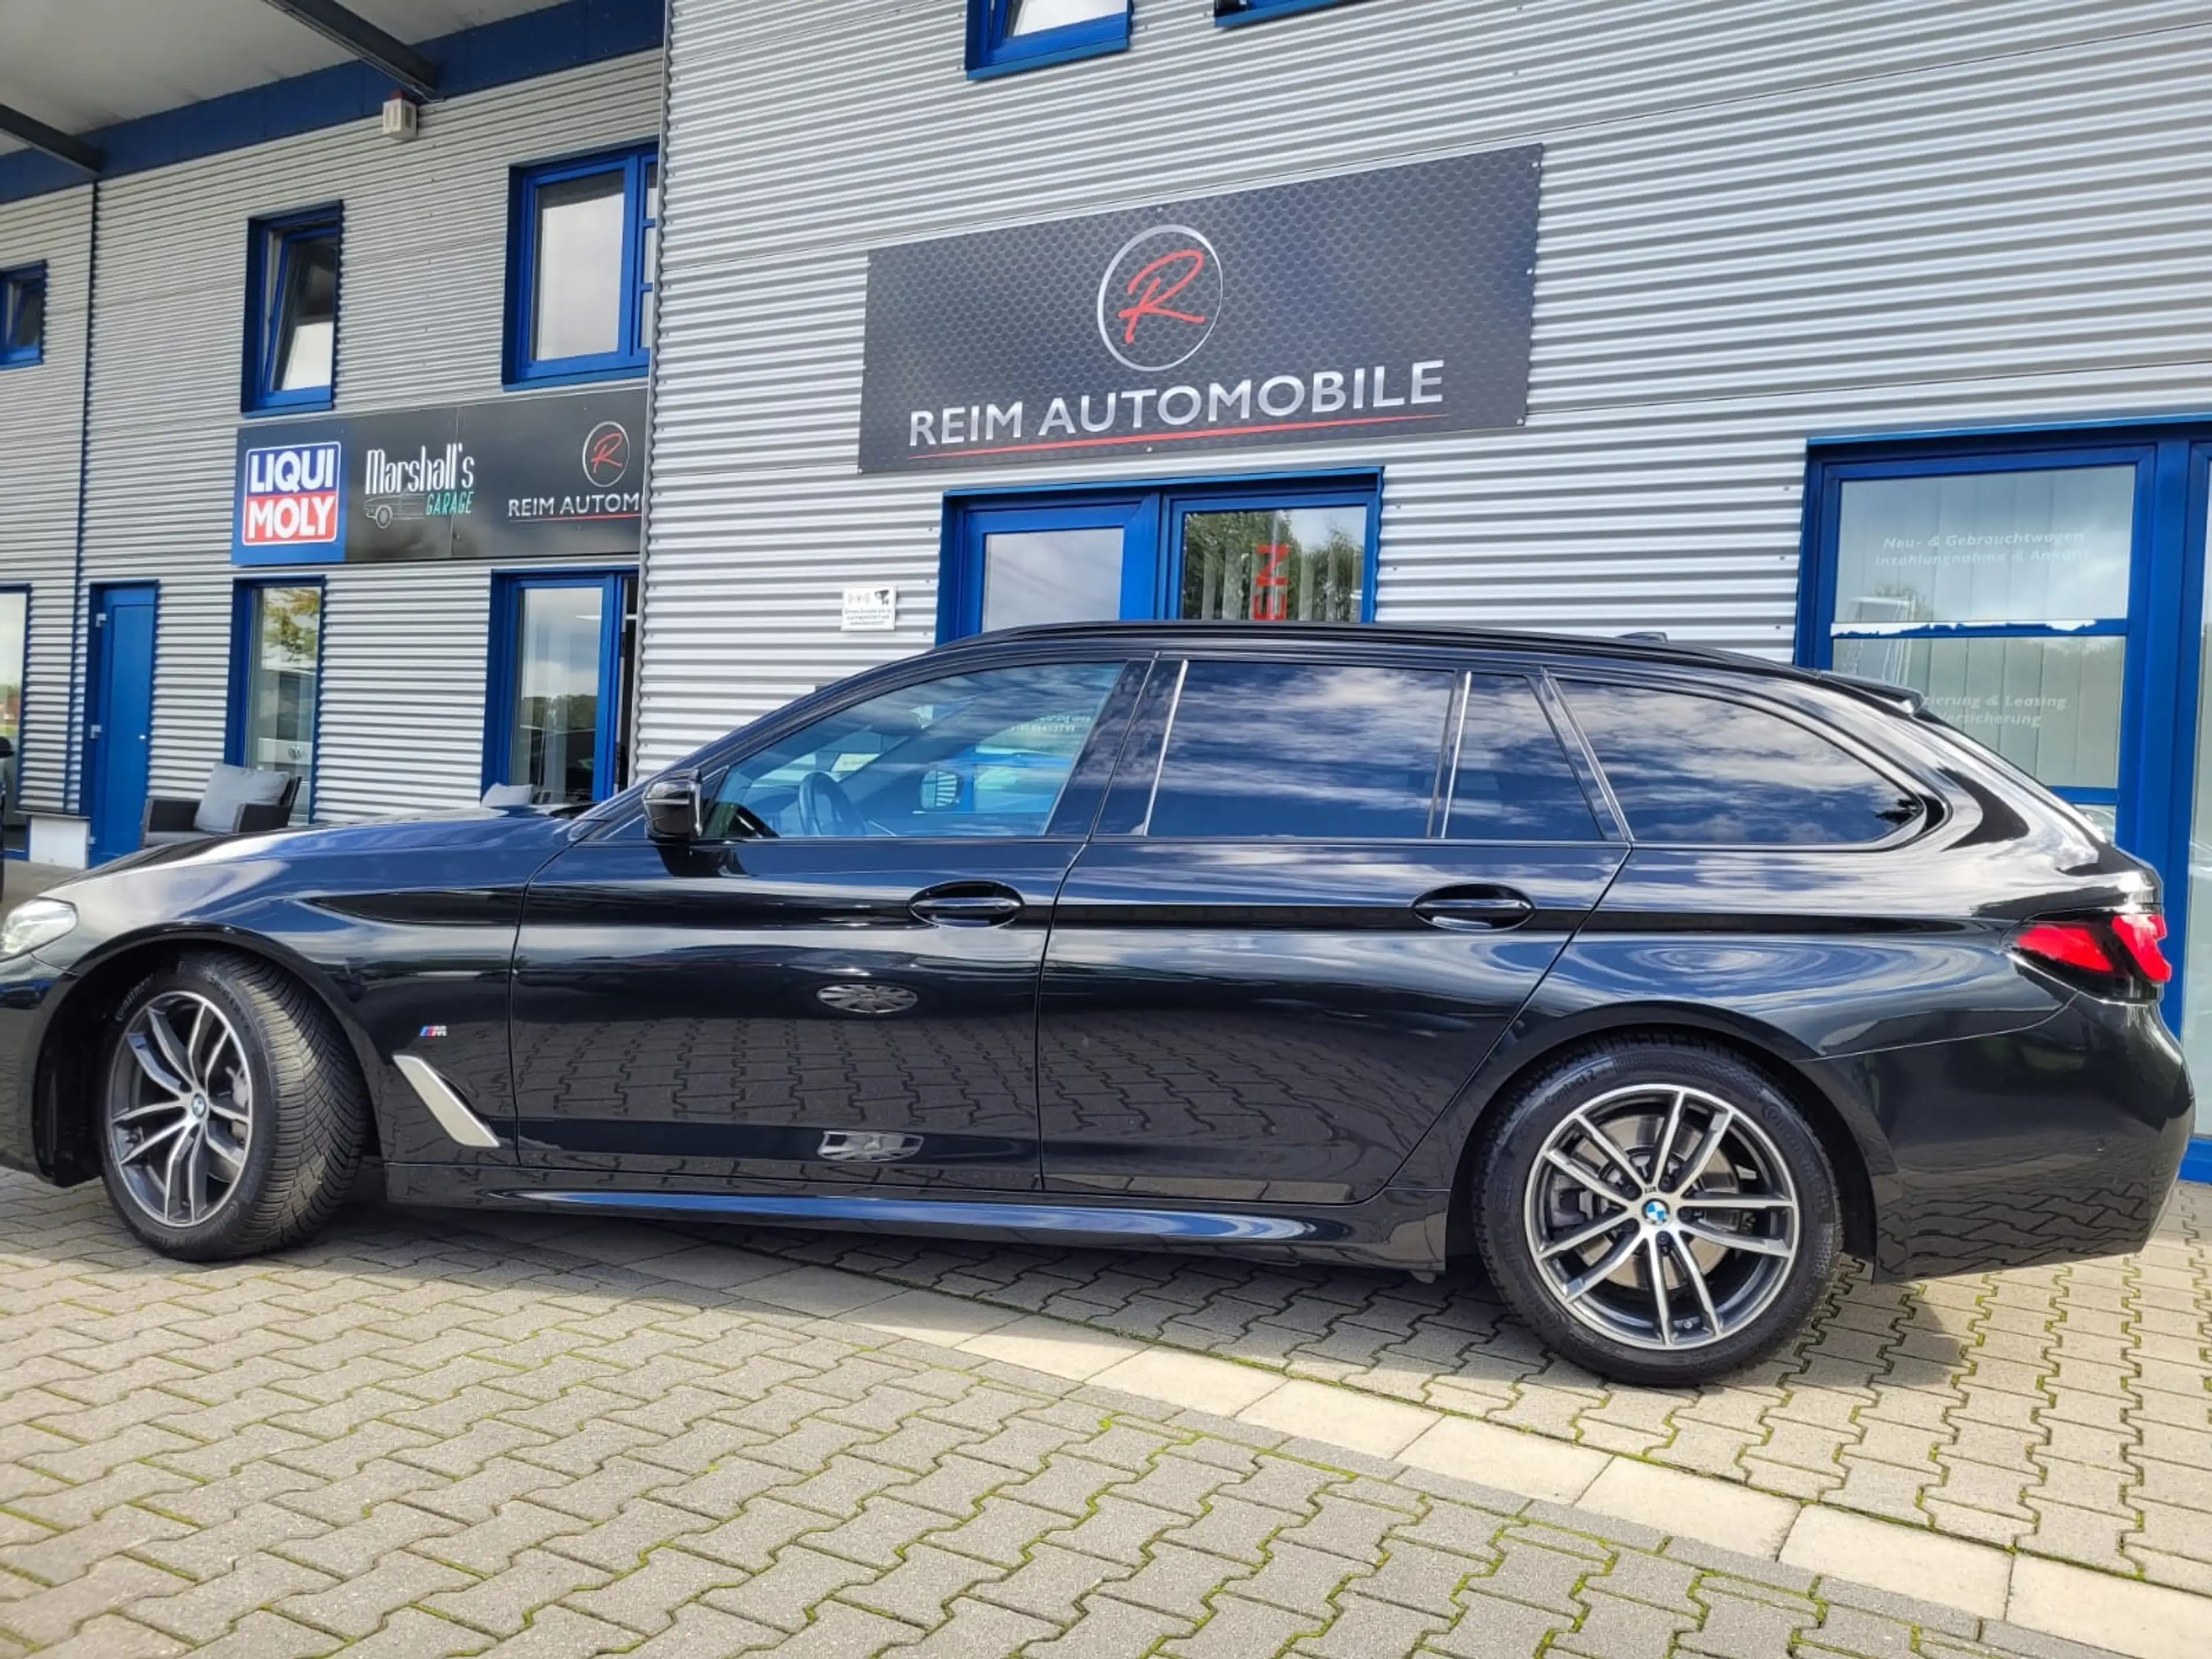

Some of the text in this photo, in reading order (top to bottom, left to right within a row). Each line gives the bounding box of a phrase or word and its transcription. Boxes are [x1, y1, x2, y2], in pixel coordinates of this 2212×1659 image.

[909, 360, 1445, 446] REIM AUTOMOBILE
[250, 448, 334, 493] LIQUI
[365, 444, 475, 494] Marshall's
[248, 497, 336, 539] MOLY
[426, 491, 475, 516] GARAGE
[508, 492, 643, 517] REIM AUTOM
[1923, 694, 1981, 709] zierung
